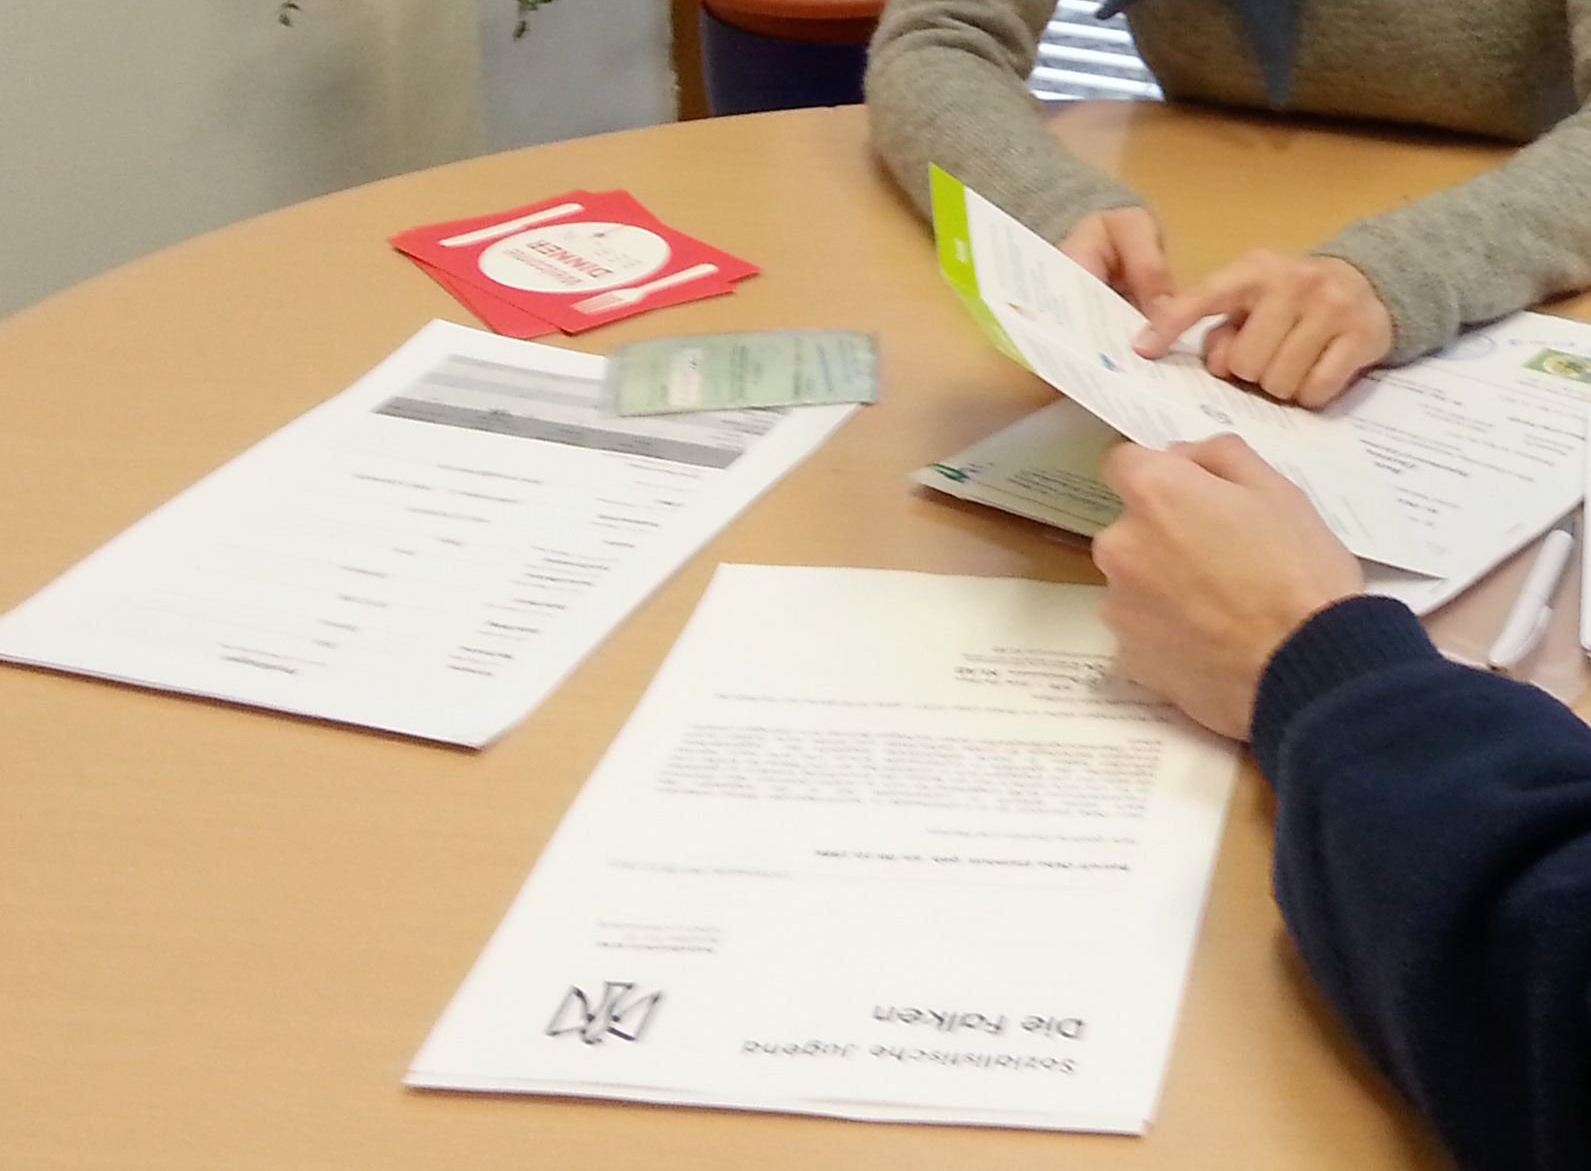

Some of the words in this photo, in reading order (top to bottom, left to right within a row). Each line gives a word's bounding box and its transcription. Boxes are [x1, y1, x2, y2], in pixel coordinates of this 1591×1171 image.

[527, 240, 614, 278] DINNER
[872, 1004, 1006, 1038] Falken
[1020, 1012, 1086, 1040] Die
[740, 1039, 856, 1060] Jugend
[868, 1044, 1076, 1075] Sozialistische
